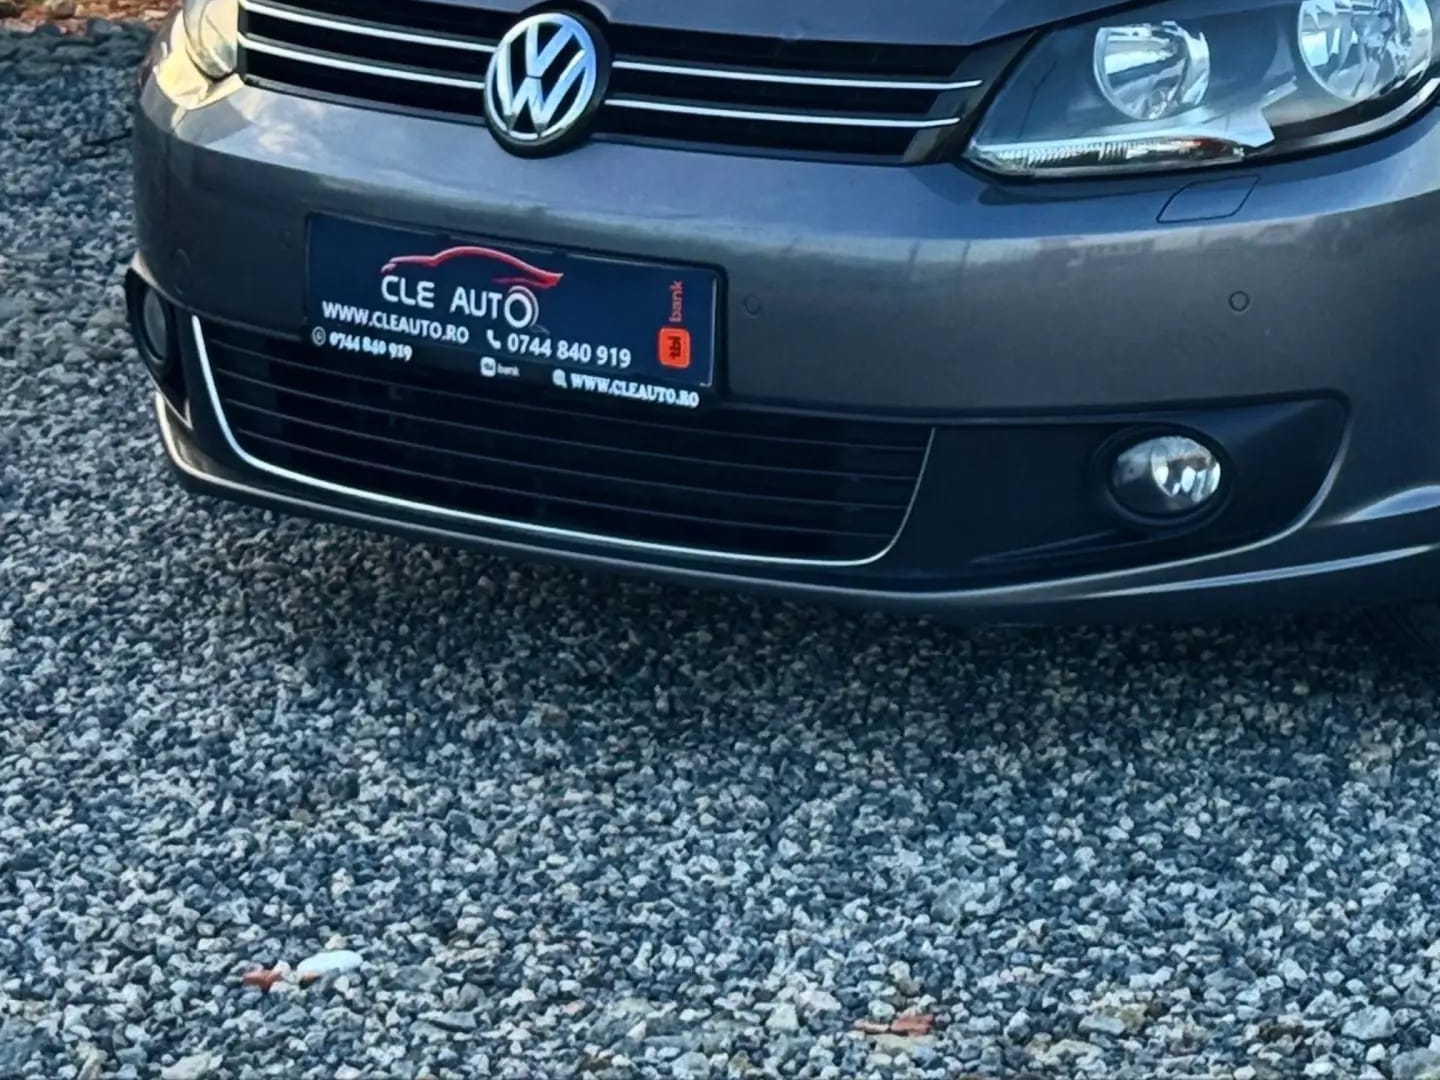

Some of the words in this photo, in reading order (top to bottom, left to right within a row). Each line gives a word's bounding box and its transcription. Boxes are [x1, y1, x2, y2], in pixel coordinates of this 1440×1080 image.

[322, 300, 470, 345] WWW.CLEAUTO.RO
[381, 275, 435, 309] CLE
[450, 285, 535, 328] AUTO
[507, 332, 552, 358] 0744
[556, 340, 592, 363] 840
[596, 345, 632, 369] 919
